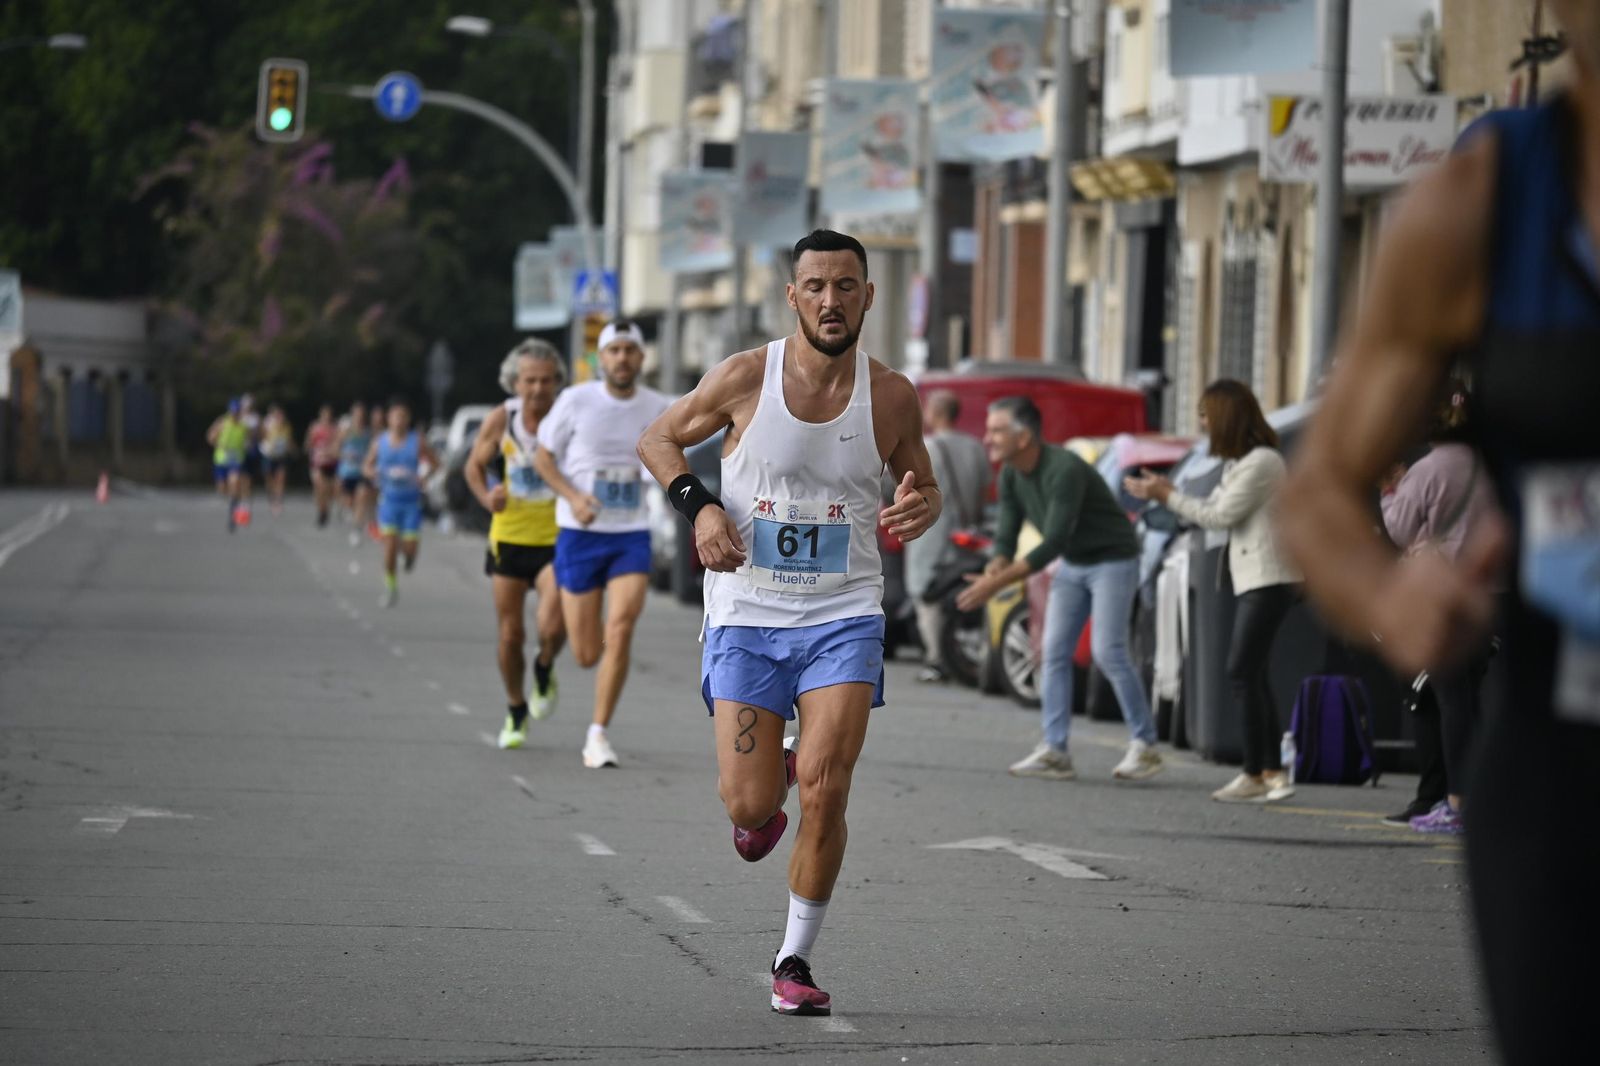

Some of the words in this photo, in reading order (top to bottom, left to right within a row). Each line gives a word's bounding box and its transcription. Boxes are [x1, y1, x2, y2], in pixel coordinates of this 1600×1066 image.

[758, 500, 777, 516] 2K
[828, 504, 846, 519] 2K
[777, 525, 819, 558] 61
[772, 571, 817, 585] Huelva
